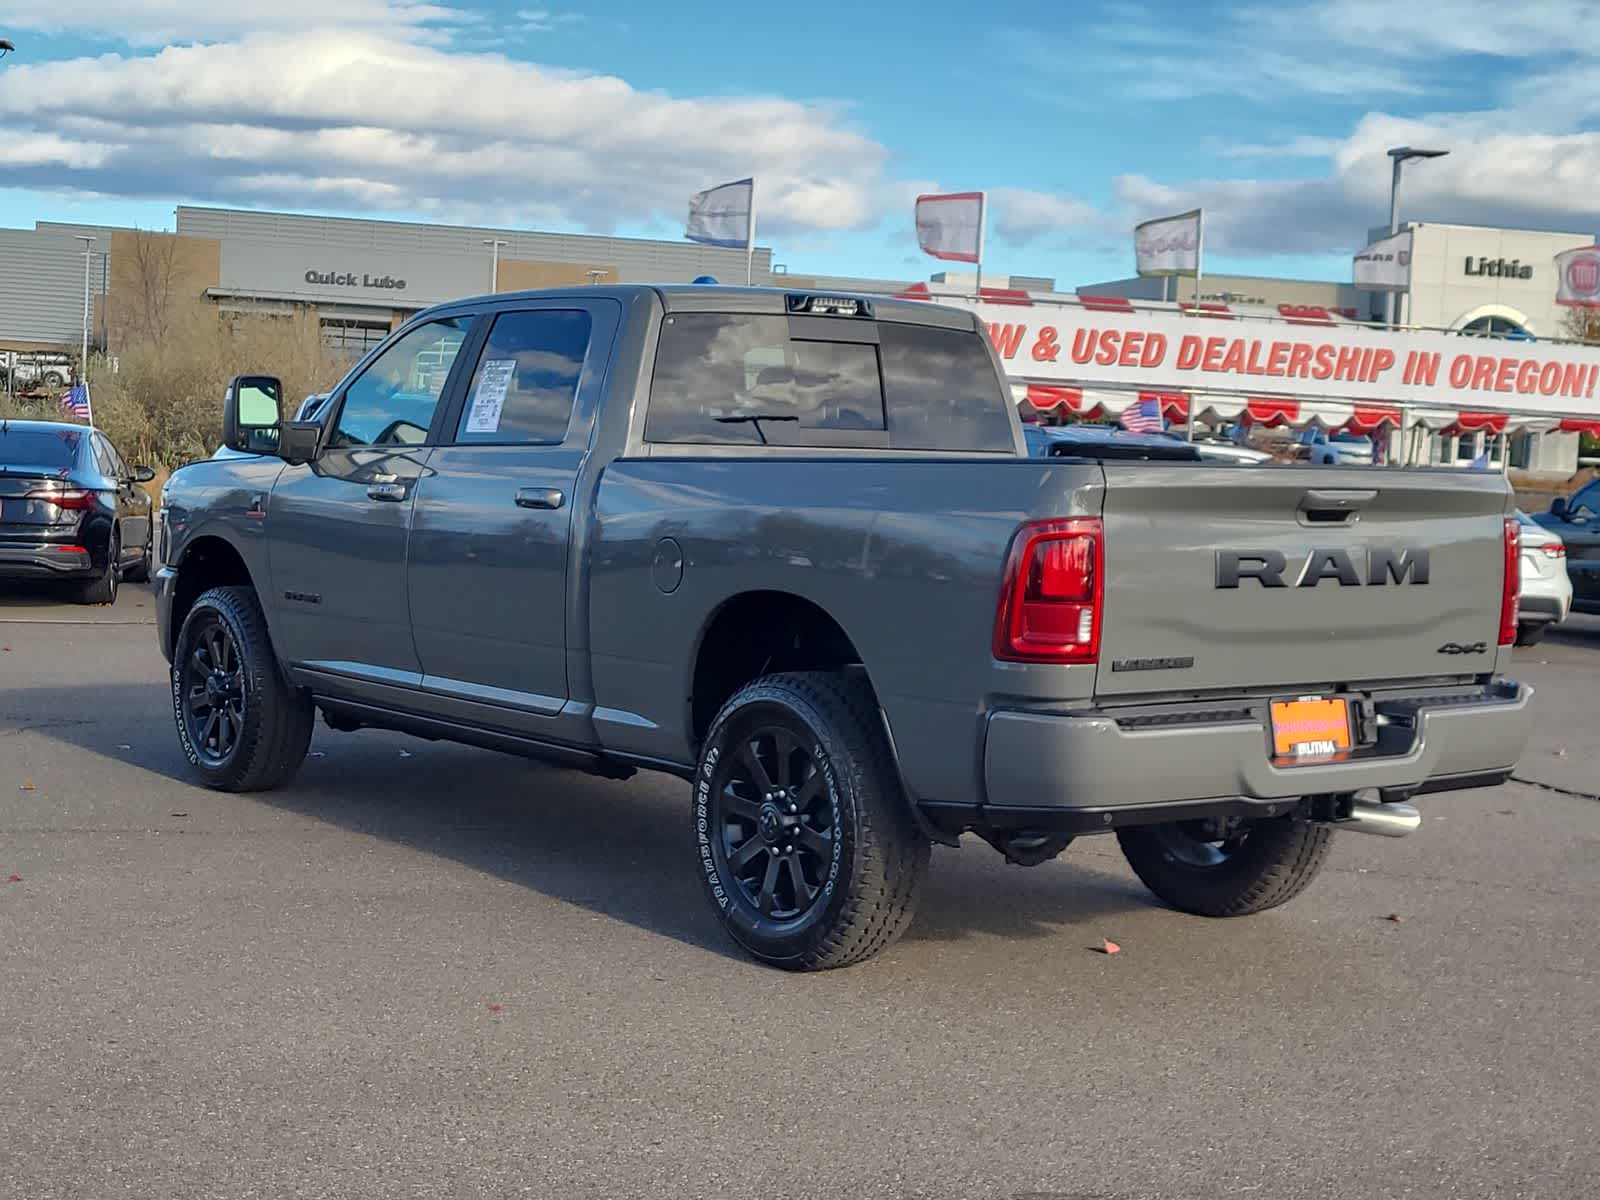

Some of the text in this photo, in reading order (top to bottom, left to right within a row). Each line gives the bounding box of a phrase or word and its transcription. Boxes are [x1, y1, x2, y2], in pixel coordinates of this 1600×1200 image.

[304, 270, 407, 289] Quick Lube
[1464, 255, 1534, 280] Lithia
[983, 322, 1600, 398] W & USED DEALERSHIP IN OREGON!
[1214, 548, 1430, 589] RAM
